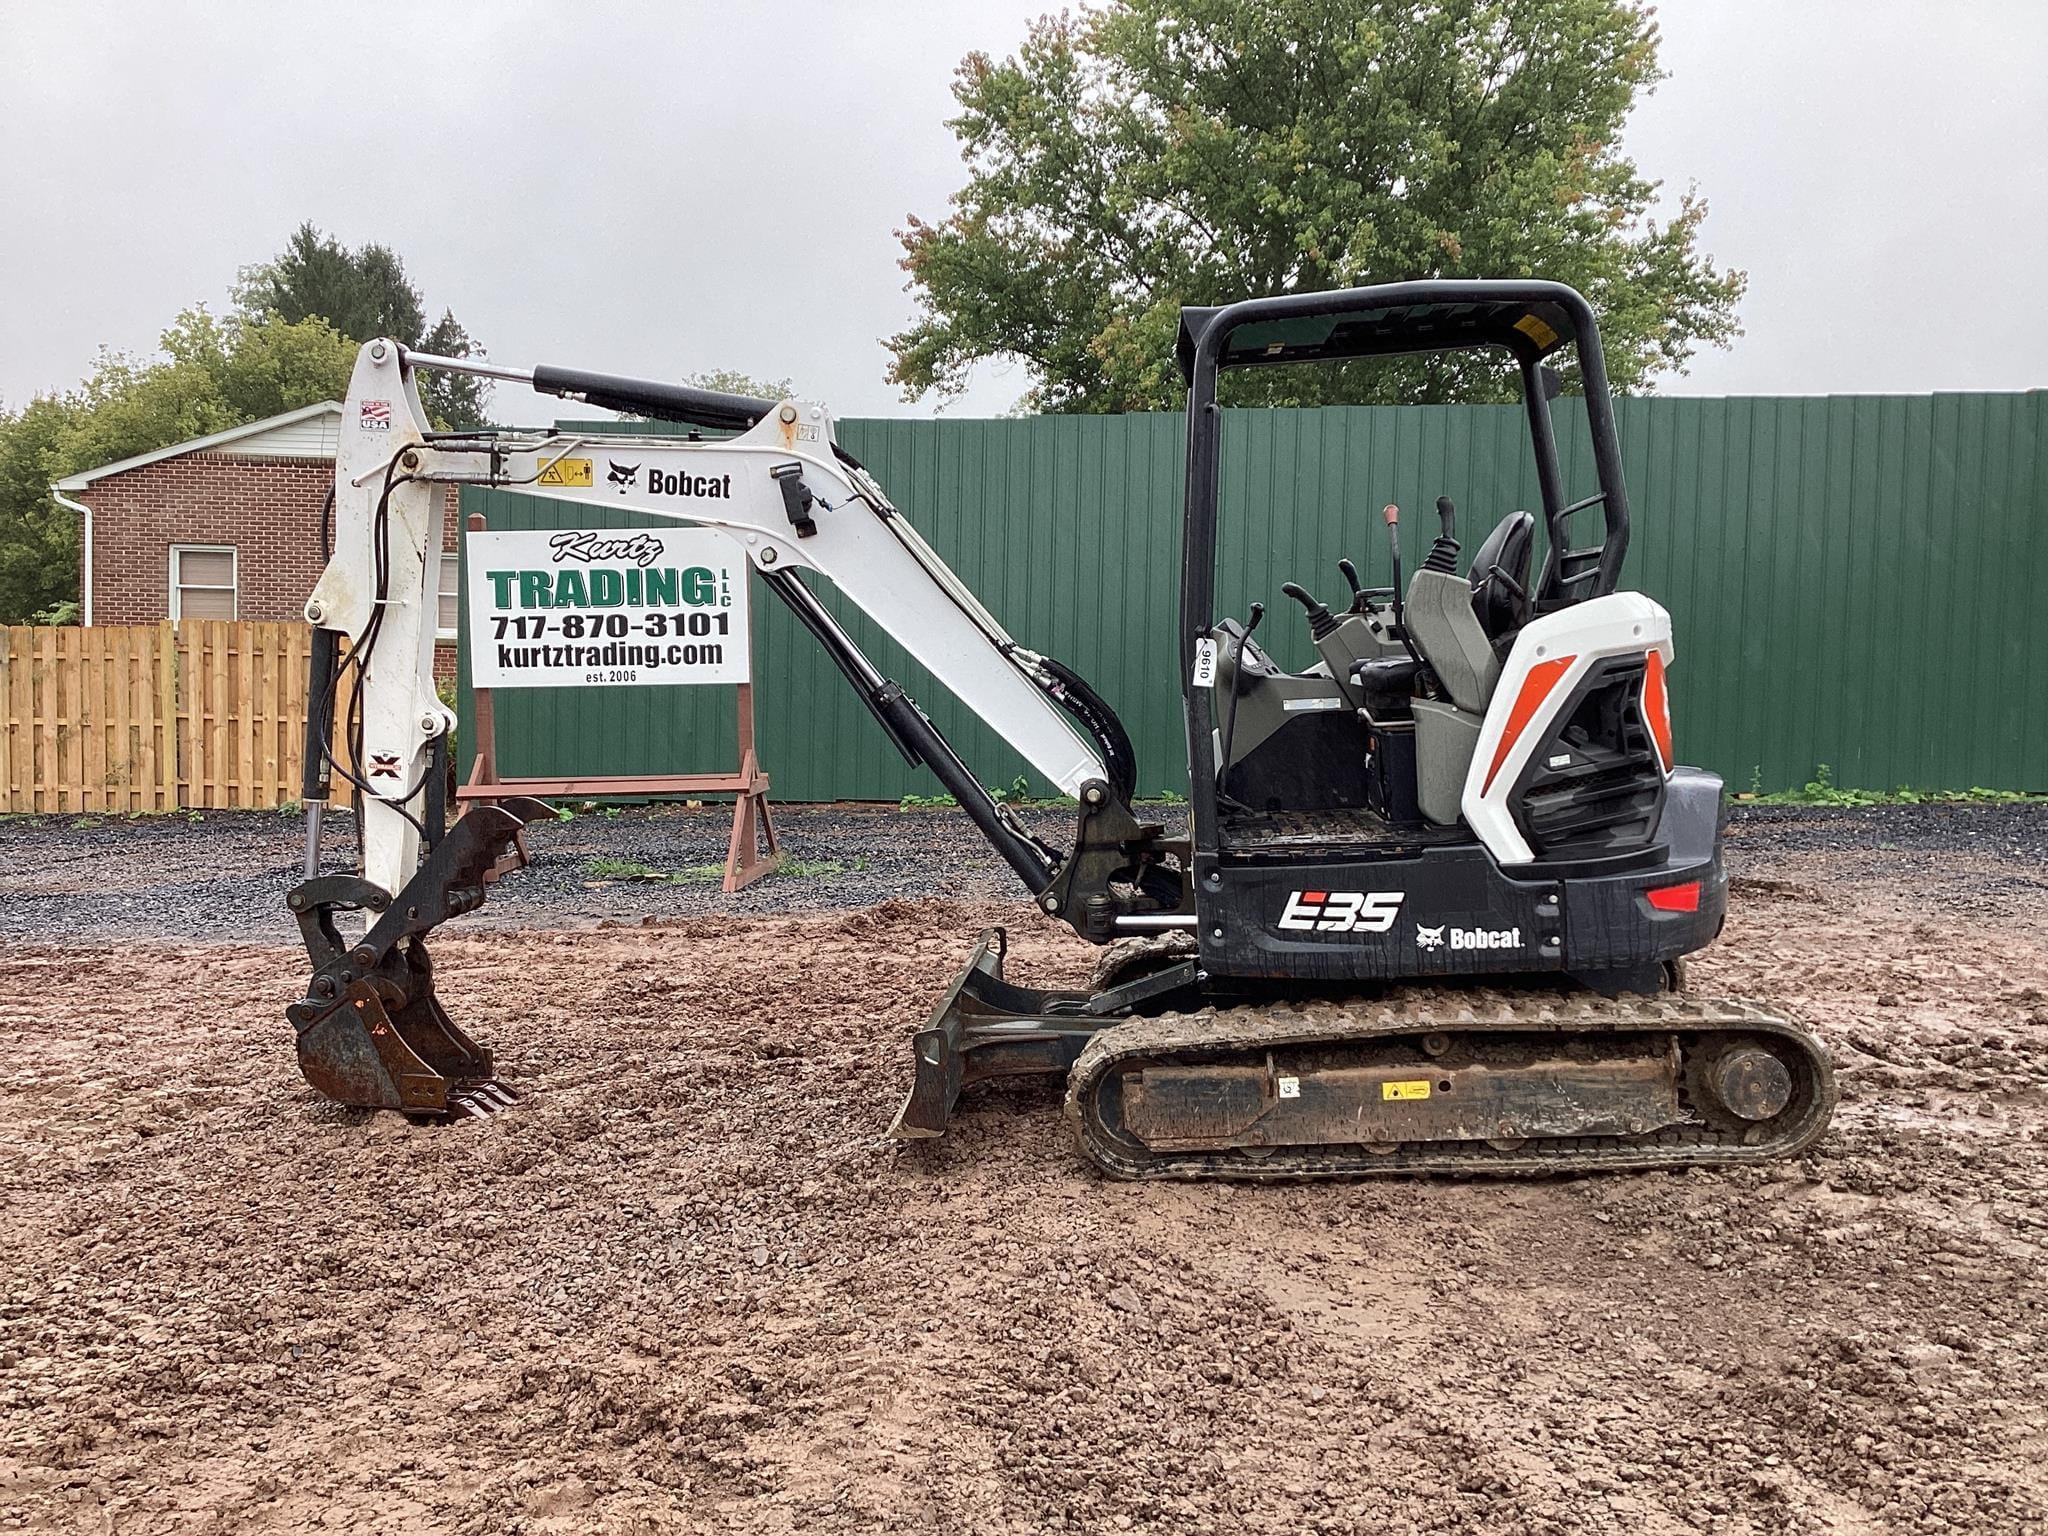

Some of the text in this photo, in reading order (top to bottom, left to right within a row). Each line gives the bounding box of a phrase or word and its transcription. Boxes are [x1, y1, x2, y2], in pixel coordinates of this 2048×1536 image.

[362, 420, 389, 429] USA
[648, 468, 731, 499] Bobcat
[549, 531, 664, 567] Kurtz
[486, 566, 731, 609] TRADING LLC
[490, 611, 729, 640] 717-870-3101
[498, 641, 723, 669] kurtztrading.com
[1199, 650, 1212, 679] 9610
[586, 670, 637, 683] est. 2006
[1277, 891, 1405, 932] E35
